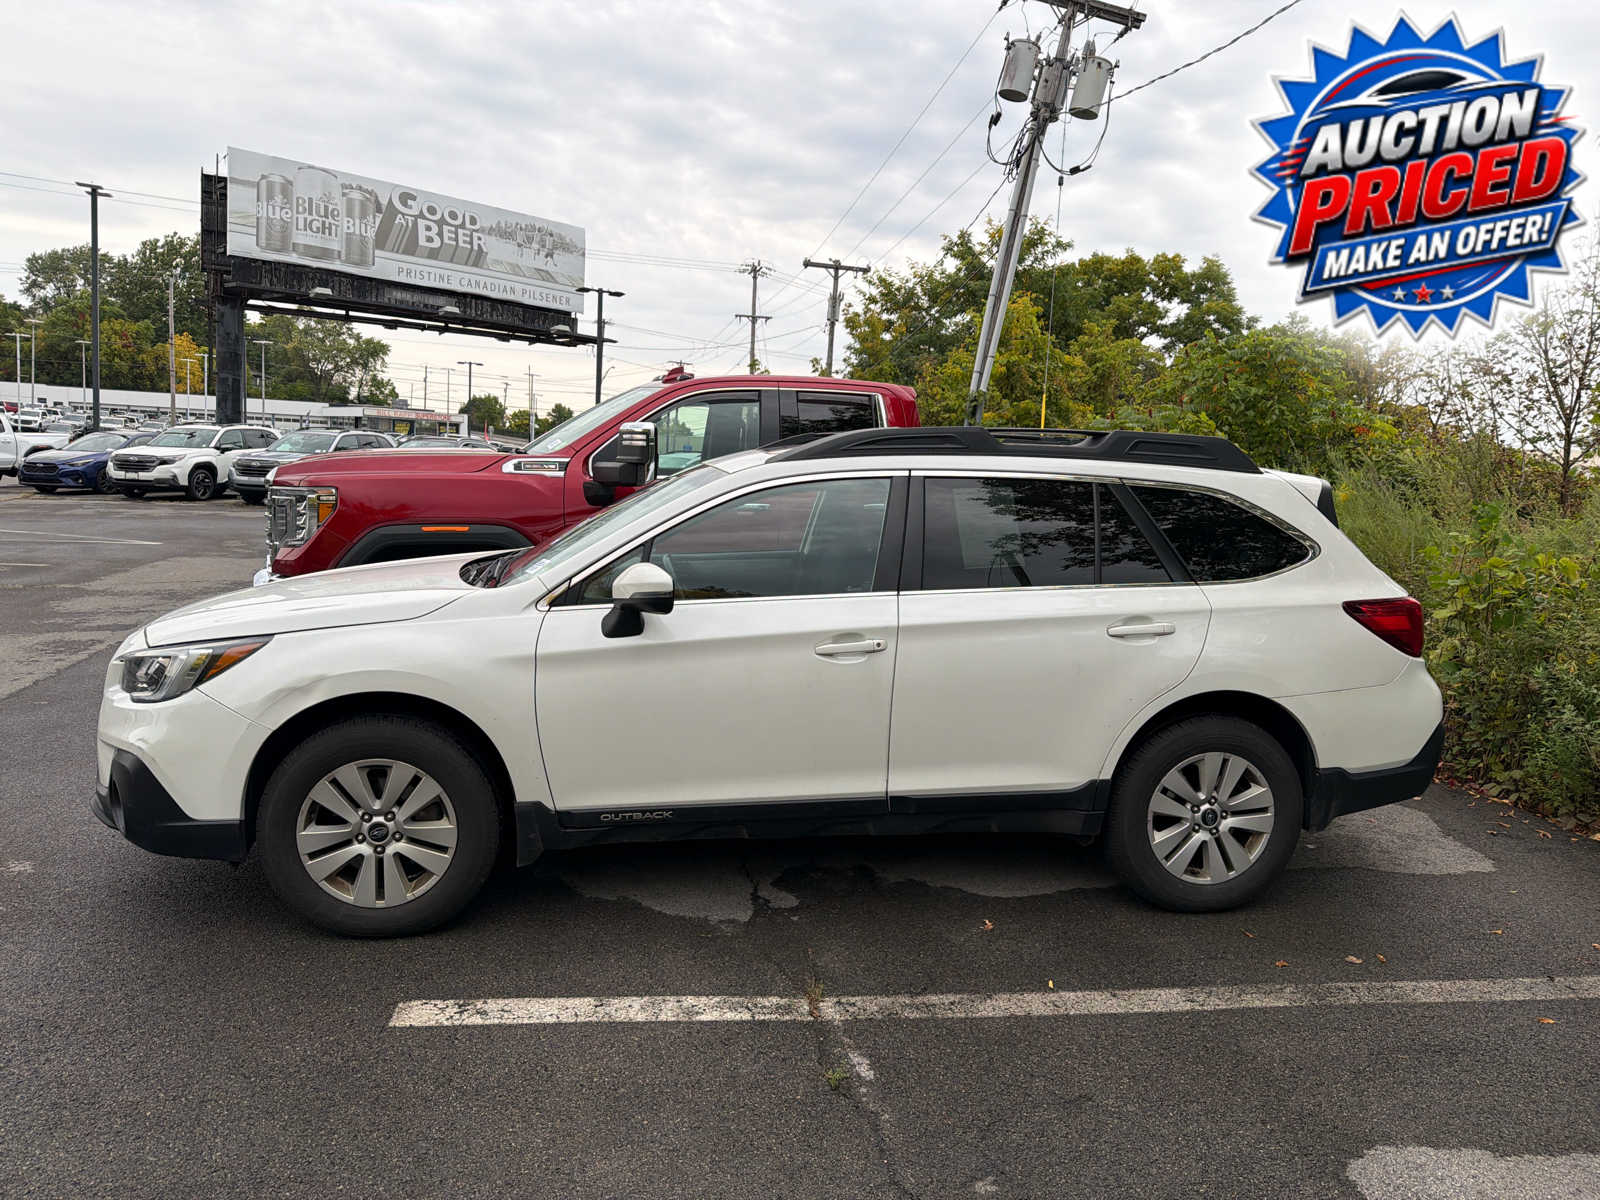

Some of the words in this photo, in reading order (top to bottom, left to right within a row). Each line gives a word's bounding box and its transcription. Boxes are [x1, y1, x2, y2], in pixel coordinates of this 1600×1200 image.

[296, 216, 339, 238] LIGHT
[391, 187, 481, 230] GOOD
[395, 213, 415, 227] AT
[417, 219, 488, 252] BEER
[397, 266, 452, 285] PRISTINE
[459, 277, 516, 296] CANADIAN
[522, 288, 571, 306] PILSENER
[600, 811, 673, 820] OUTBACK
